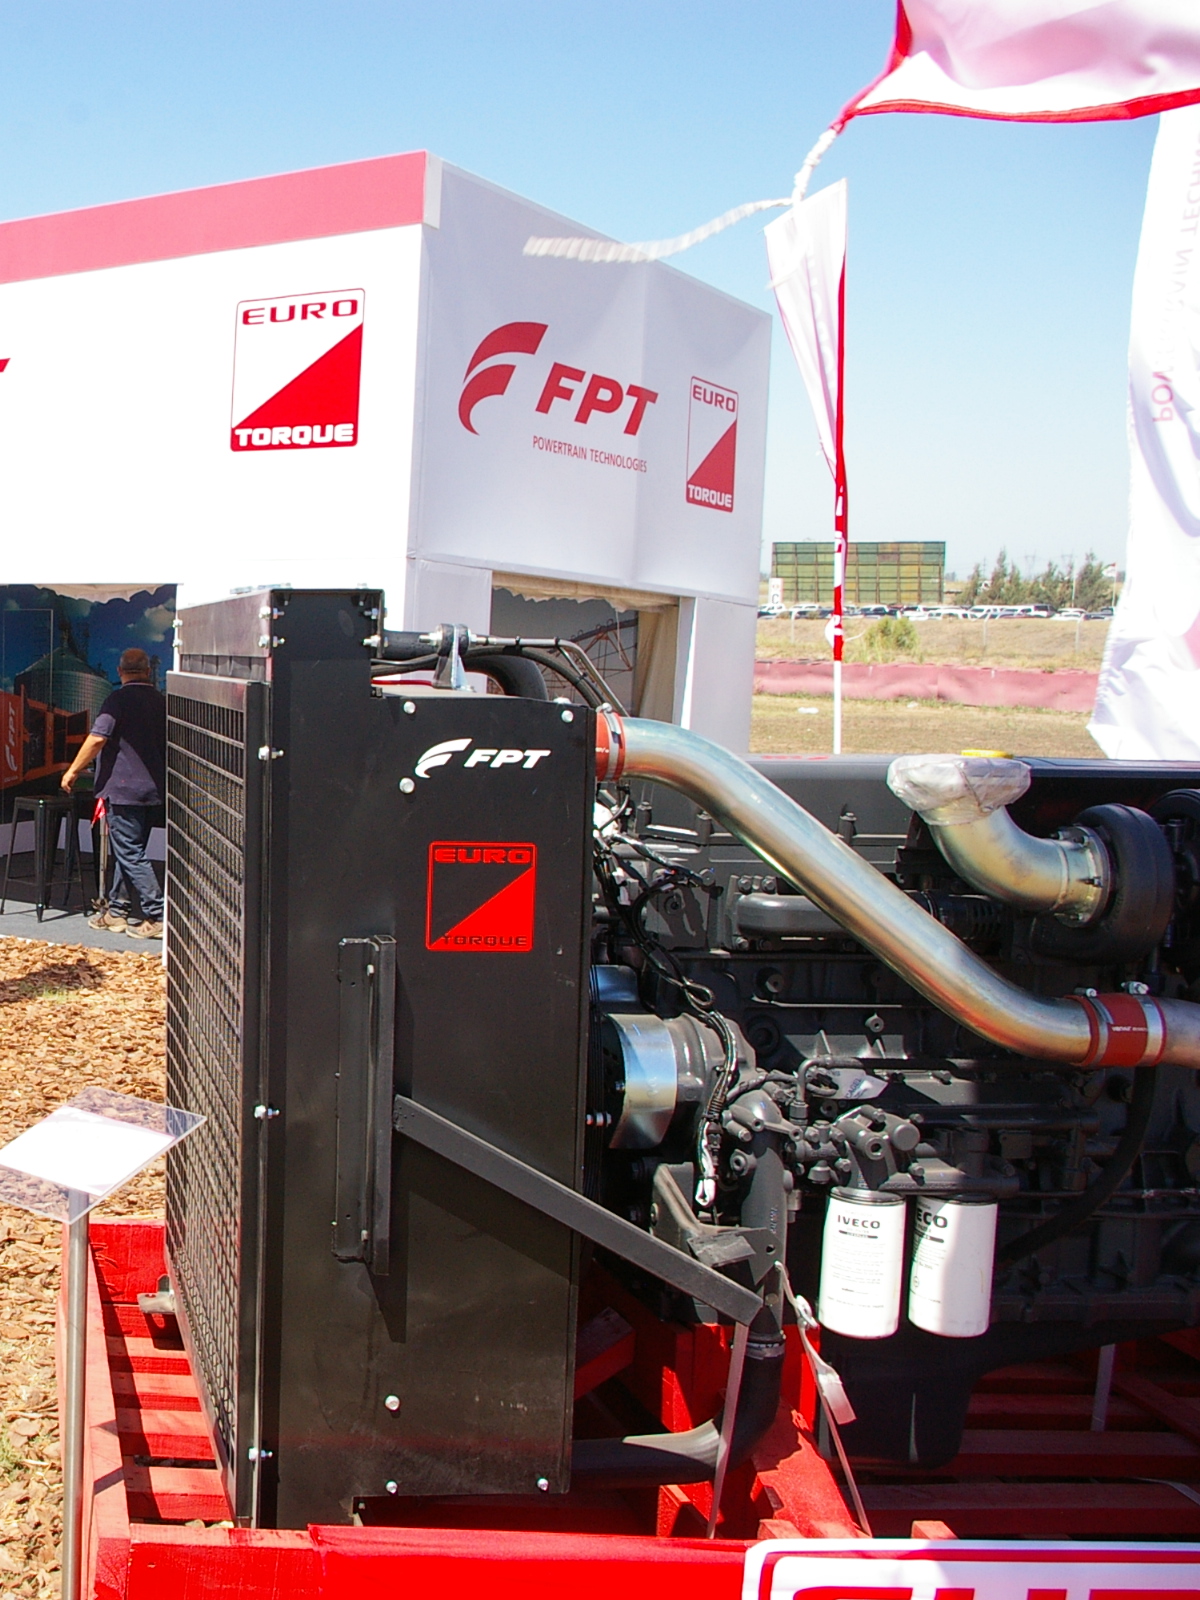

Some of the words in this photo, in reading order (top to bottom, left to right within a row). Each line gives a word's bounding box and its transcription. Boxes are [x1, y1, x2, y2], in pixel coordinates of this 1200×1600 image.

[242, 299, 358, 325] EURO
[535, 362, 658, 436] FPT
[692, 384, 737, 414] EURO
[234, 423, 354, 447] TORQUE
[532, 435, 588, 461] POWERTRAIN
[589, 447, 648, 473] TECHNOLOGIES
[687, 484, 733, 509] TORQUE
[464, 748, 551, 769] FPT
[434, 847, 532, 864] EURO
[443, 934, 528, 947] TORQUE
[836, 1213, 882, 1230] IVECO
[916, 1207, 949, 1229] ECO
